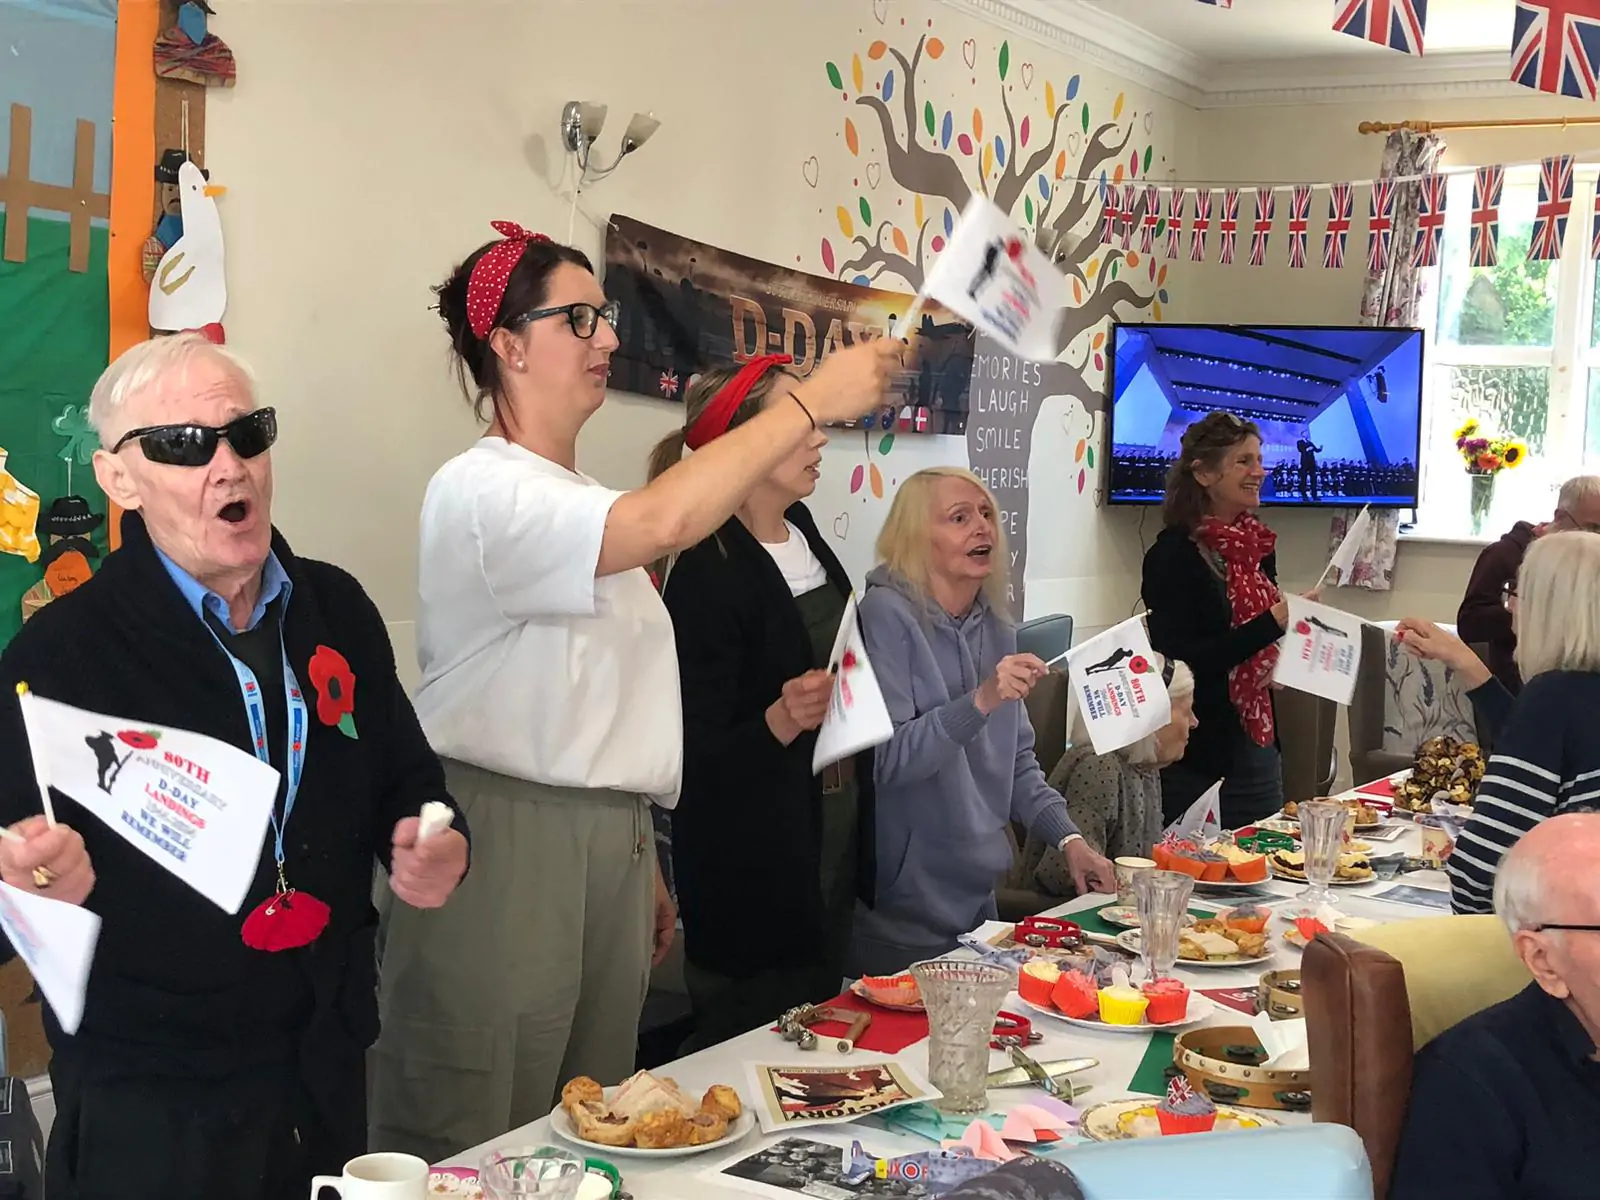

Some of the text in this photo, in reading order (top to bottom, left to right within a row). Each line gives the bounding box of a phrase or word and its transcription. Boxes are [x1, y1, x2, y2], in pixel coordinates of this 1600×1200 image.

[978, 388, 1029, 416] LAUGH
[976, 427, 1022, 452] SMILE
[1083, 684, 1098, 720] REMEMBER
[1106, 682, 1121, 716] LANDINGS
[1114, 685, 1127, 707] D-DAY
[1130, 678, 1146, 704] 80TH
[1096, 700, 1106, 718] WILL
[163, 751, 211, 784] 80TH
[145, 782, 206, 829] LANDINGS
[159, 778, 199, 810] D-DAY
[121, 809, 187, 863] REMEMBER
